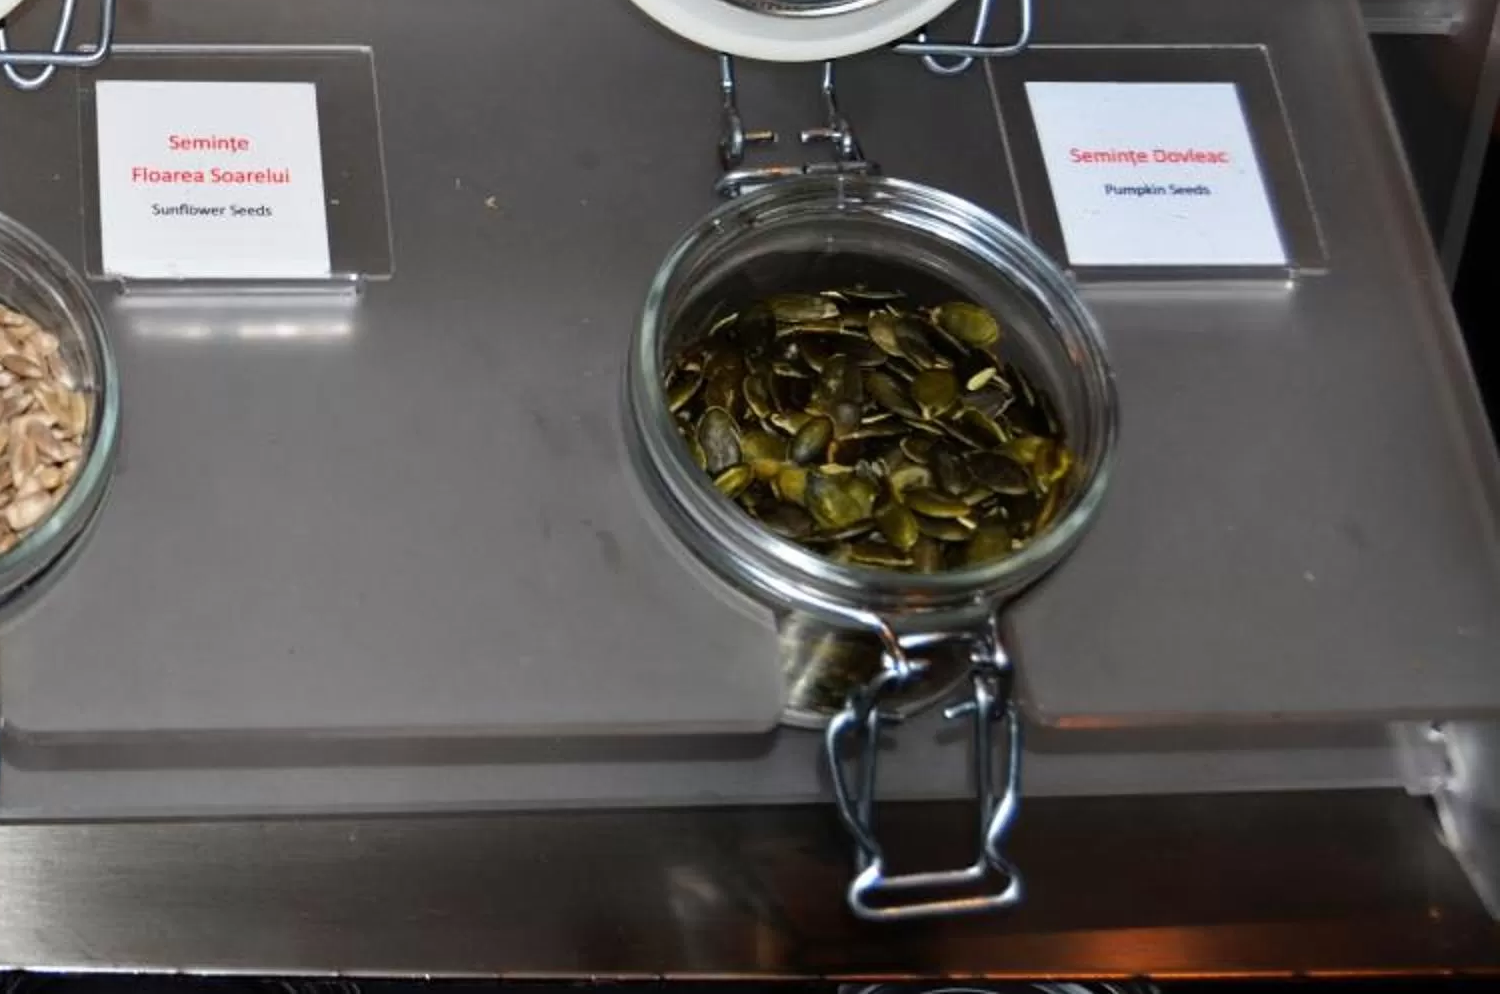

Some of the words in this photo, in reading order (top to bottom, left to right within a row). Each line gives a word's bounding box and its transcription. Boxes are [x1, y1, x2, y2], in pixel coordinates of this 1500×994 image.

[1153, 149, 1229, 164] Dovleac
[132, 167, 205, 183] Floarea
[210, 167, 290, 183] Soarelui
[1104, 183, 1167, 197] Pumpkin
[1169, 183, 1211, 196] Seeds
[152, 203, 226, 217] Sunflower
[230, 205, 273, 217] Seeds
